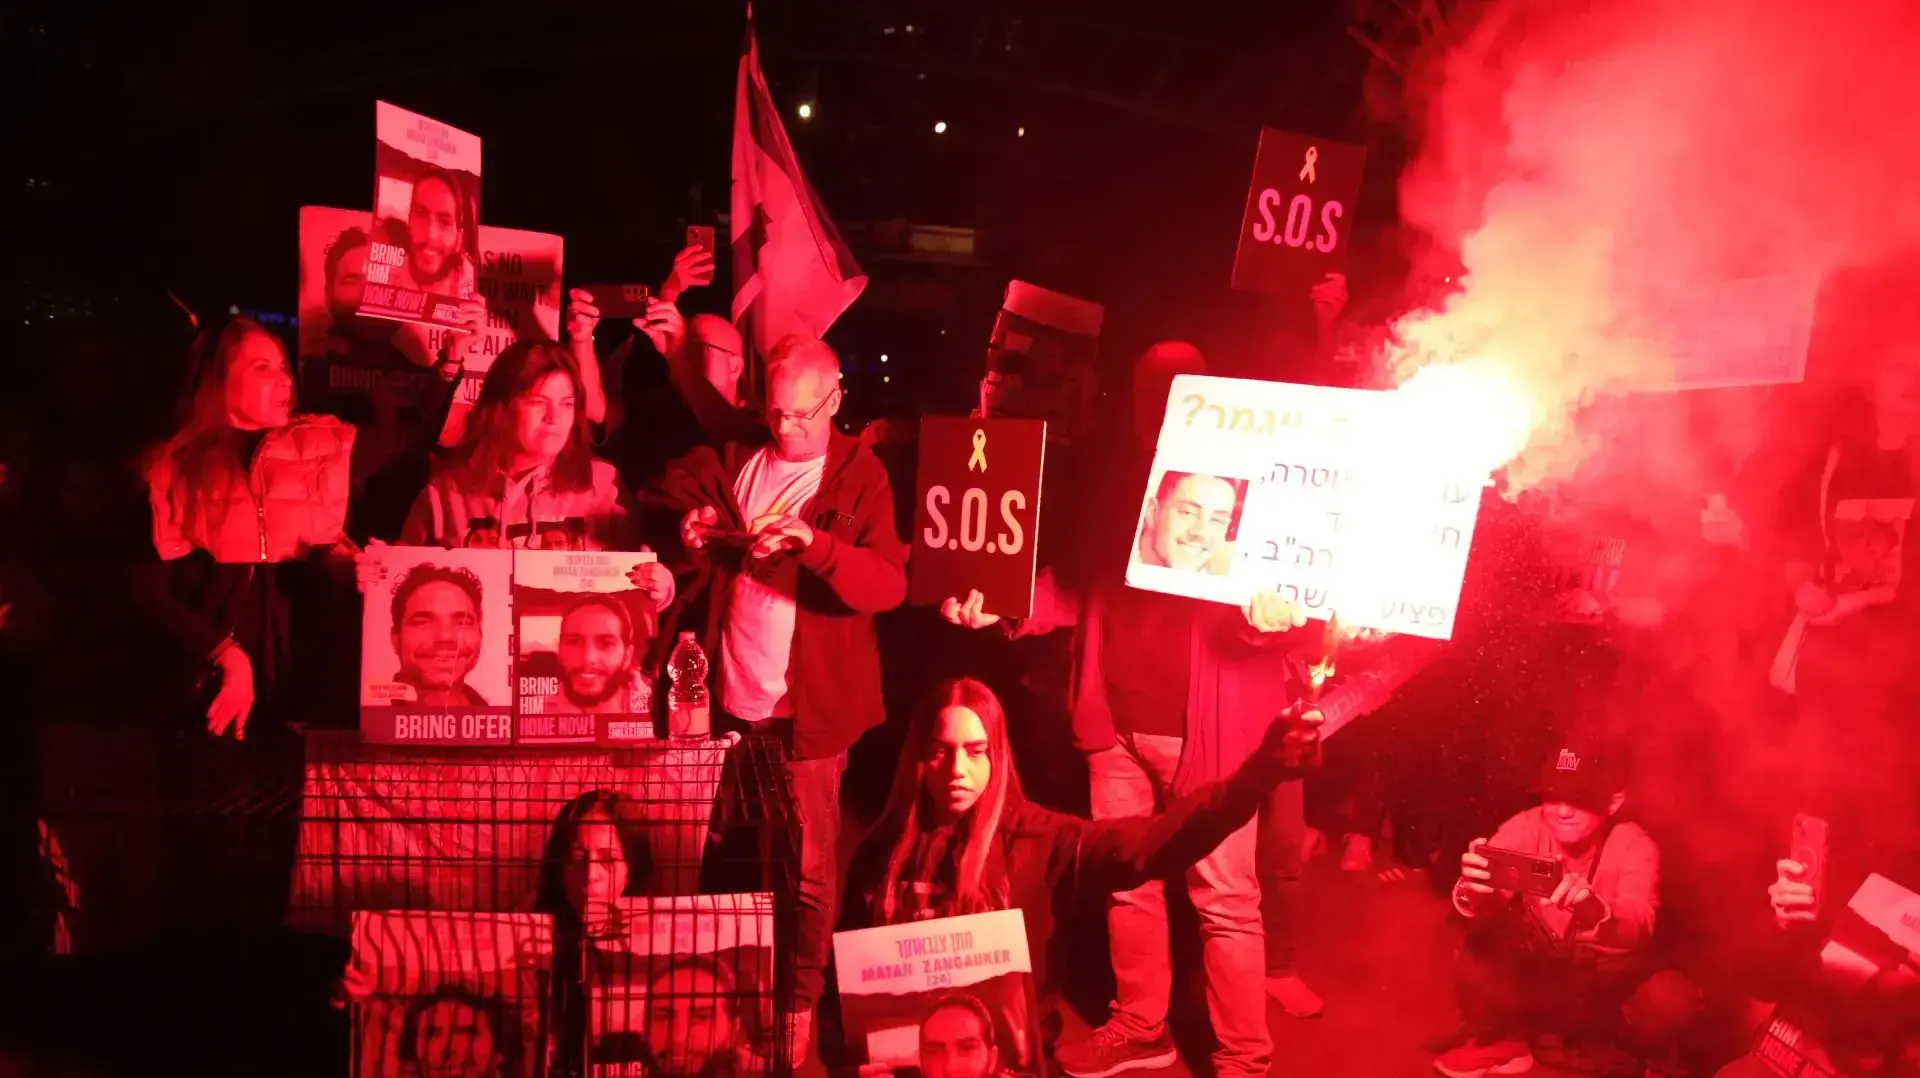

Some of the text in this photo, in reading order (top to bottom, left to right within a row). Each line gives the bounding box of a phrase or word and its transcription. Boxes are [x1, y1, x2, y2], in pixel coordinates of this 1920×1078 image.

[1253, 188, 1343, 253] S.O.S
[370, 242, 405, 267] BRING
[367, 262, 391, 285] HIM
[362, 285, 395, 308] HOME
[394, 289, 428, 313] NOW!
[923, 485, 1026, 555] S.O.S
[520, 677, 558, 696] BRING
[520, 696, 545, 715] HIM
[395, 714, 511, 739] BRING OFER
[520, 714, 595, 737] HOME NOW!
[861, 950, 1012, 983] MATAN ZANGAUKER
[1768, 1018, 1801, 1048] HIM
